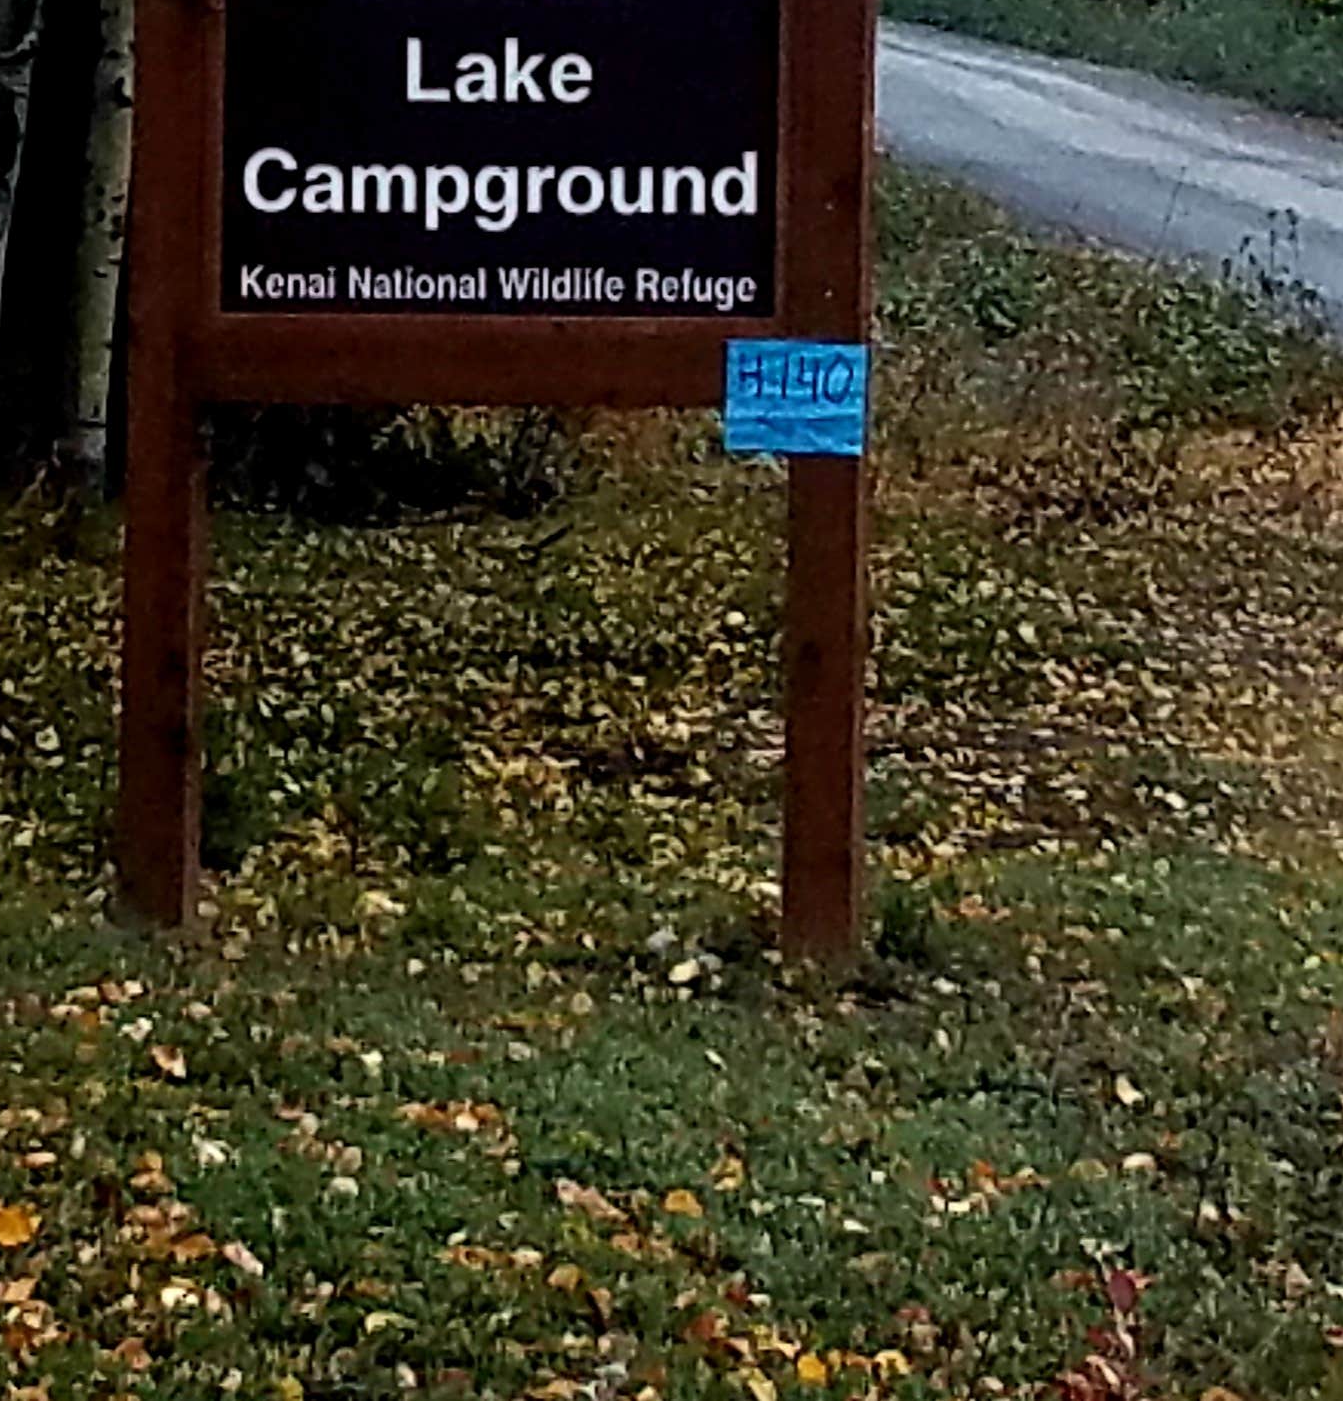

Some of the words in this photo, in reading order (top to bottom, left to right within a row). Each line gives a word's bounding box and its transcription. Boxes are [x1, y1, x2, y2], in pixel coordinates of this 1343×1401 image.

[406, 37, 593, 103] Lake
[243, 147, 758, 232] Campground
[240, 265, 337, 300] Kenai
[348, 266, 487, 301] National
[498, 267, 625, 302] Wildlife
[636, 268, 757, 311] Refuge
